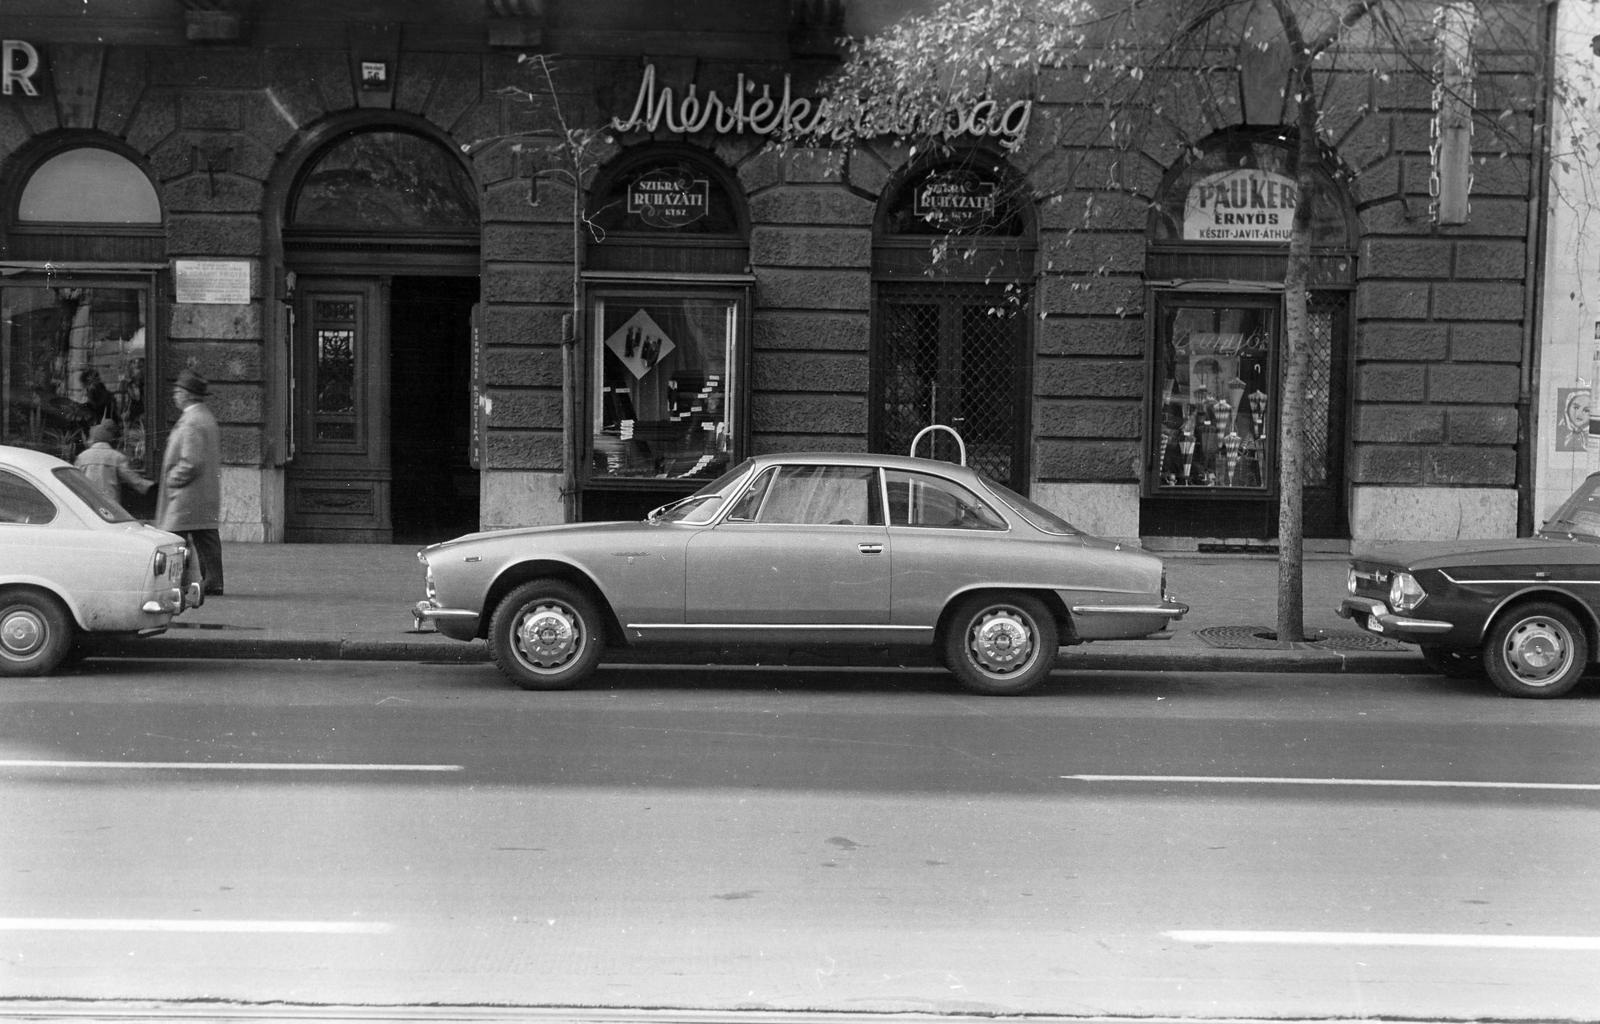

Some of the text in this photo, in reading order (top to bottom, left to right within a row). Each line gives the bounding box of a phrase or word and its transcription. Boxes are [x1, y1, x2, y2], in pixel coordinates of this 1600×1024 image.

[2, 40, 39, 96] R
[640, 181, 680, 191] SZIKRA
[1199, 178, 1297, 209] PAUKER
[634, 192, 702, 206] RUHÁZATI
